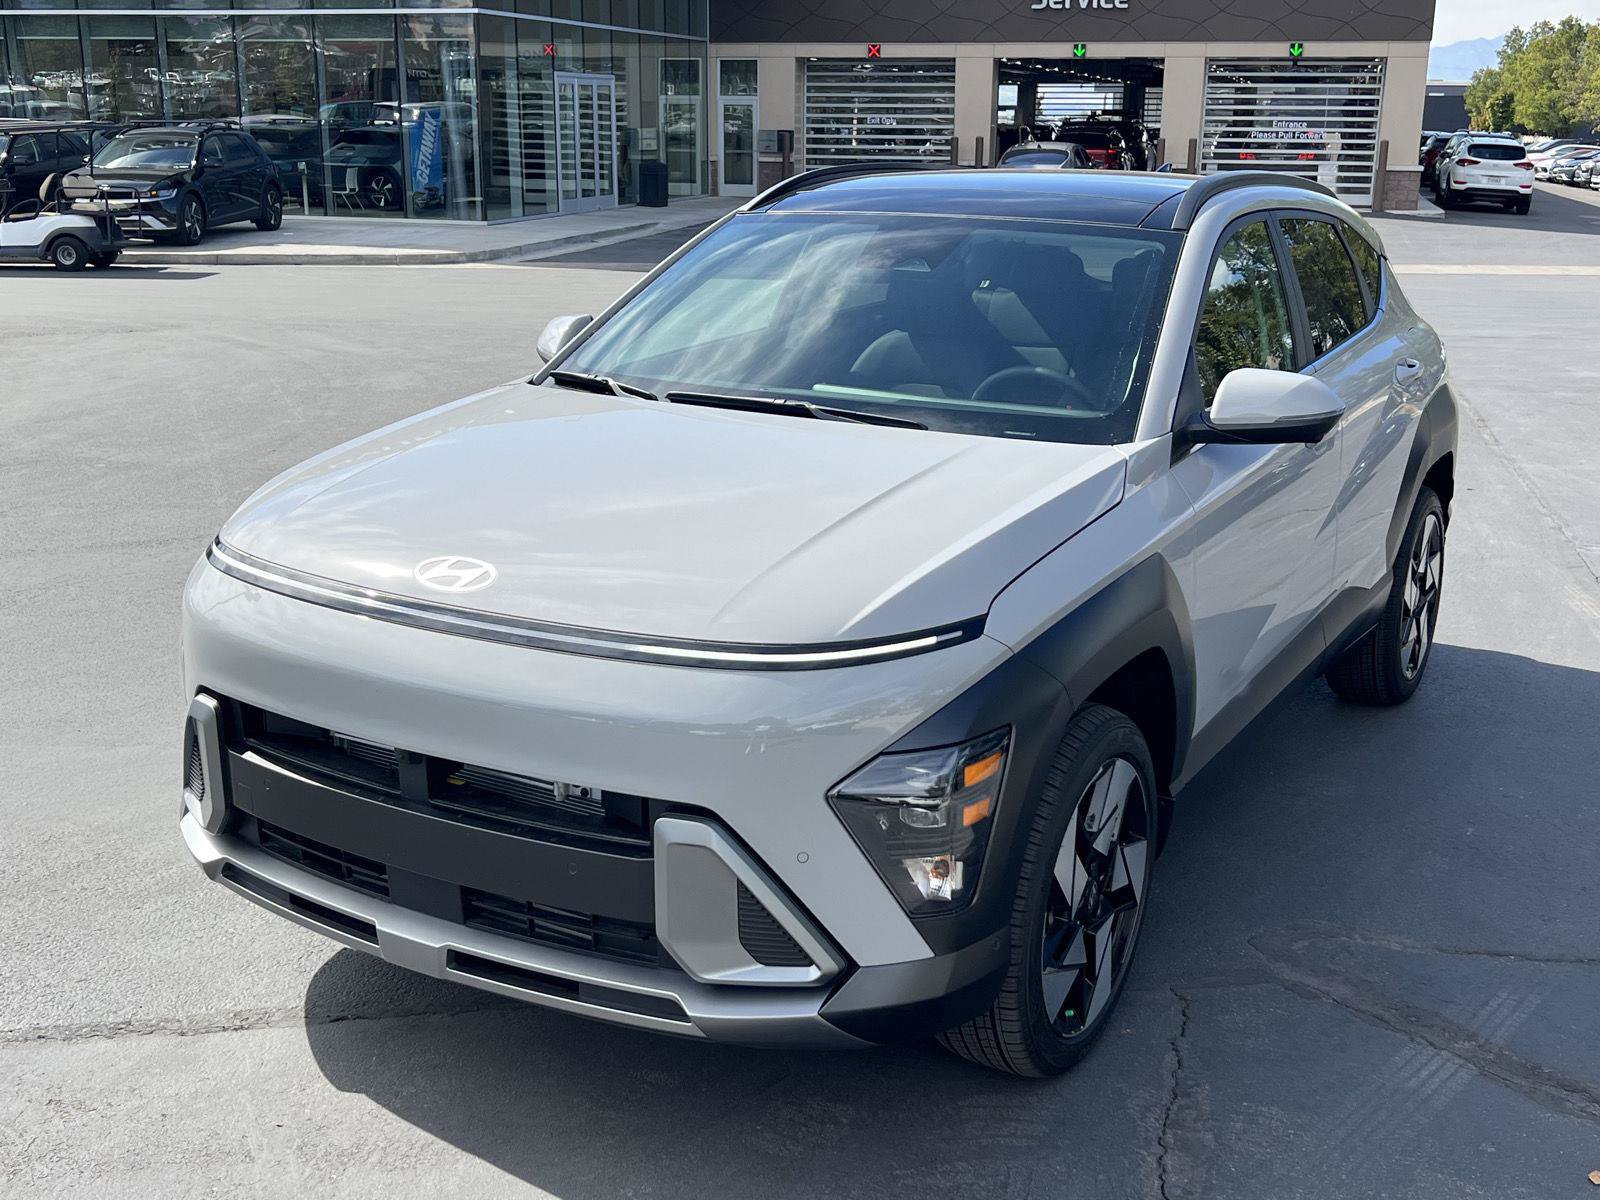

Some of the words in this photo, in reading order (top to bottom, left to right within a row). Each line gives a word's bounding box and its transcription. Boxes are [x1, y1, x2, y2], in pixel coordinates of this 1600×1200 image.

[867, 116, 880, 124] Exit
[1272, 120, 1308, 128] Entrance
[1251, 131, 1277, 139] Please
[1279, 131, 1293, 139] Pull
[1295, 131, 1327, 139] Forward
[416, 111, 437, 184] GETAWAY
